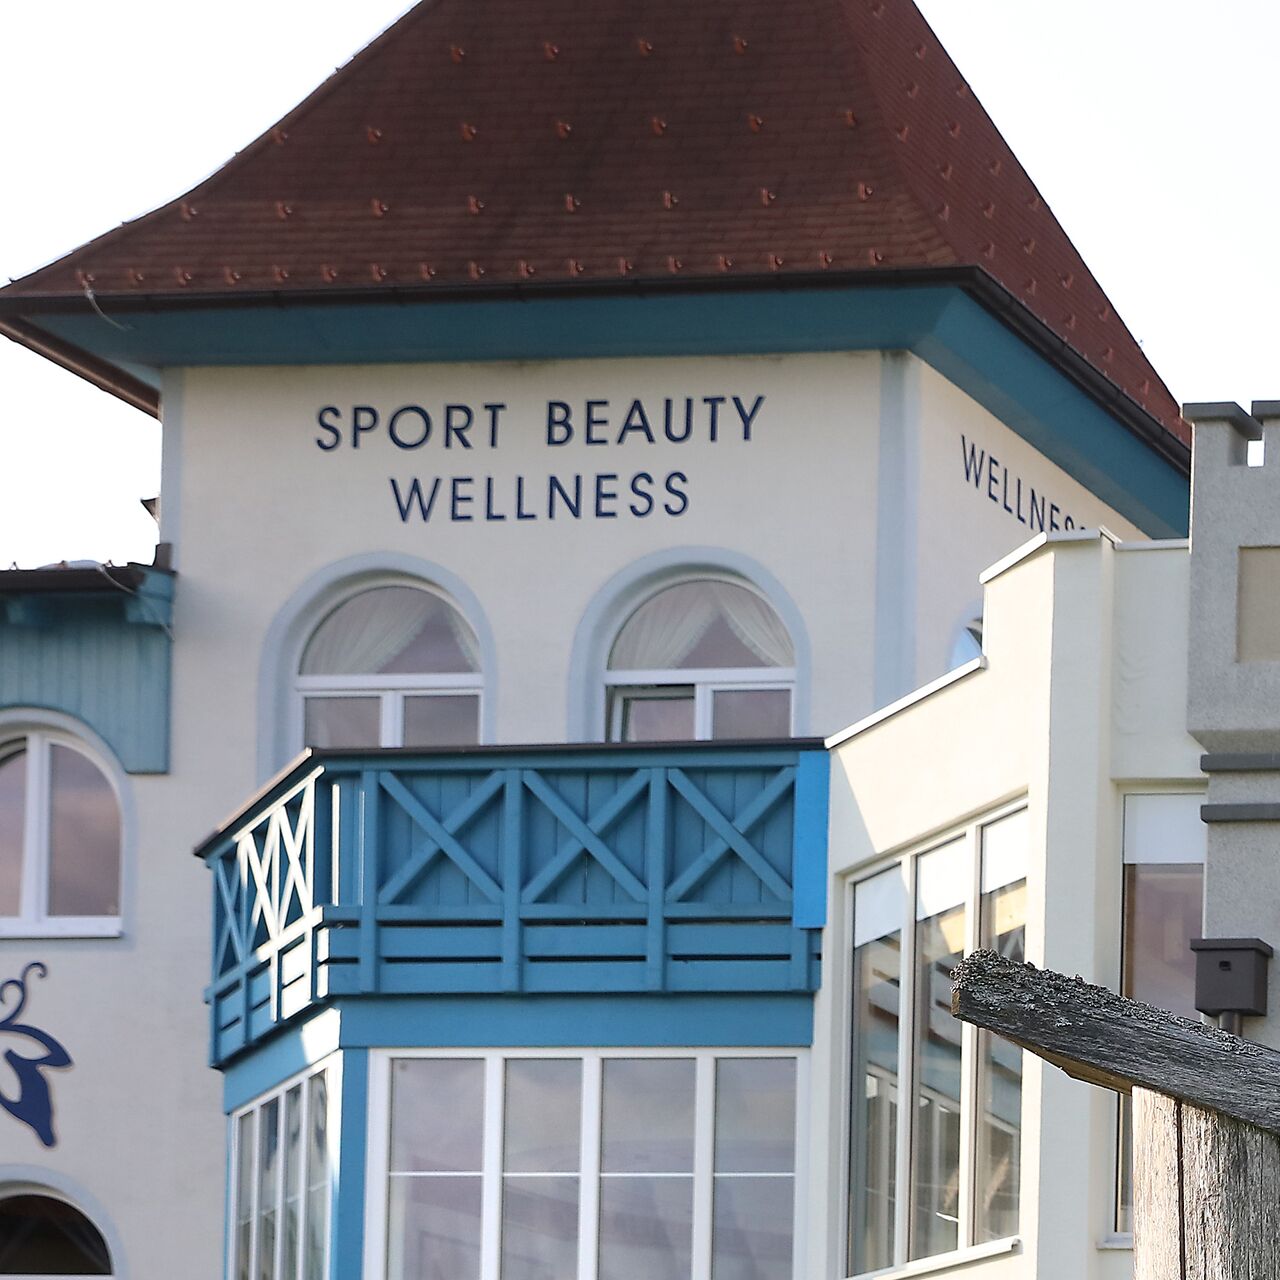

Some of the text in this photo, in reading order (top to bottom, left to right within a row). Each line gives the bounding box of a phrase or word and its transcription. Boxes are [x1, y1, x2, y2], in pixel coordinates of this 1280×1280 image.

[316, 395, 766, 452] SPORT BEAUTY
[389, 471, 690, 522] WELLNESS
[961, 434, 1086, 532] WELLNE
